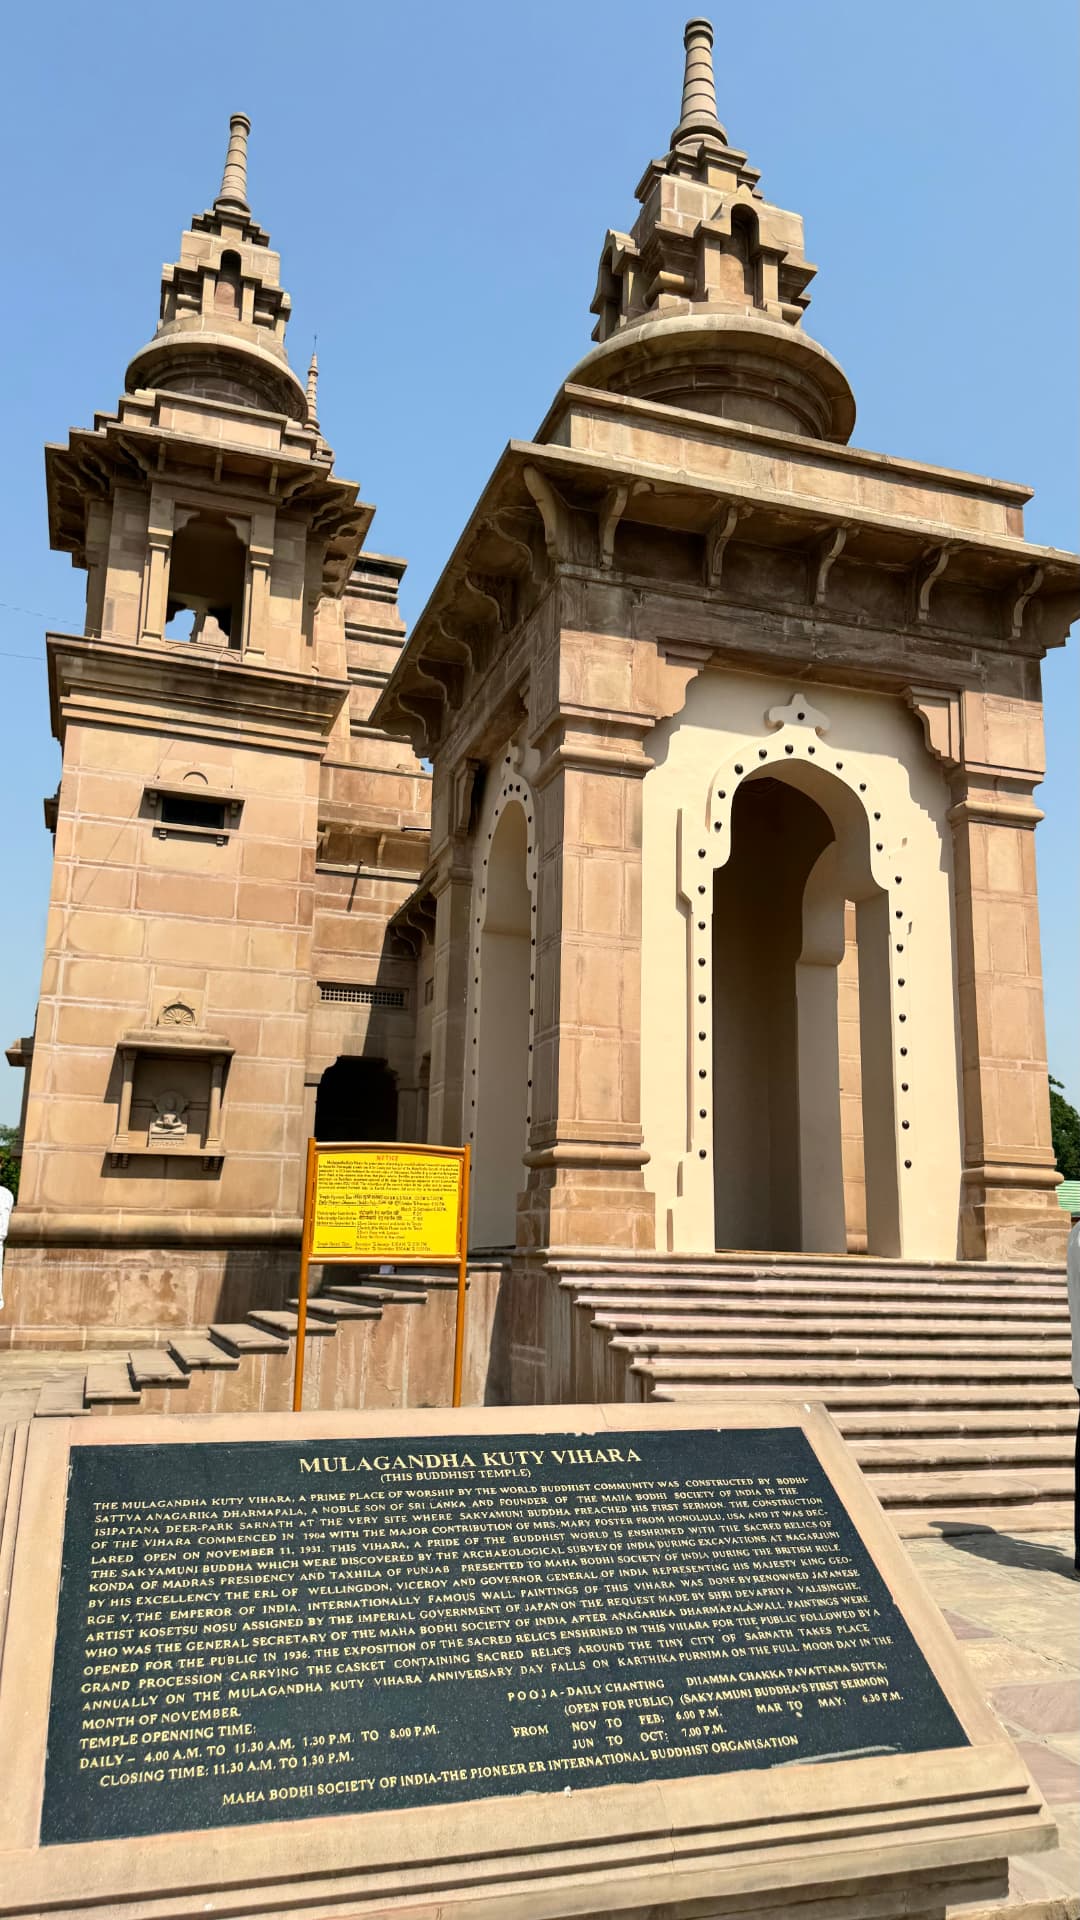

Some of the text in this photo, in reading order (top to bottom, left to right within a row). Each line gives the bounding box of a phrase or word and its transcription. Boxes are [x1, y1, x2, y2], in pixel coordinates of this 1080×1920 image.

[298, 1448, 641, 1472] MULAGANDHA KUTY VIHARA
[380, 1467, 531, 1483] (THIS BUDDHIST TEMPLE)
[92, 1501, 118, 1510] THE
[121, 1498, 207, 1509] MULAGANDHA
[211, 1496, 243, 1505] KUTY
[310, 1492, 346, 1502] PRIME
[349, 1491, 385, 1500] PLACE
[387, 1490, 403, 1498] OF
[404, 1488, 454, 1498] WORSHIP
[457, 1487, 472, 1495] BY
[473, 1487, 497, 1495] THE
[498, 1485, 537, 1493] WORLD
[539, 1483, 590, 1492] BUDDHIST
[593, 1481, 654, 1490] COMMUNITY
[684, 1478, 753, 1487] CONSTRUCTED
[756, 1477, 770, 1485] BY
[94, 1525, 159, 1536] ISIPATANA
[165, 1522, 233, 1533] DEER-PARK
[239, 1520, 293, 1530] SARNATH
[298, 1518, 314, 1527] AT
[319, 1517, 343, 1526] THE
[348, 1516, 378, 1524] VERY
[383, 1514, 408, 1524] SITE
[411, 1512, 452, 1521] WHERE
[459, 1509, 523, 1520] SAKYAMUNI
[526, 1507, 571, 1517] BUDDHA
[573, 1505, 627, 1514] PREACHED
[630, 1504, 648, 1512] HIS
[650, 1503, 679, 1511] FIRST
[727, 1500, 749, 1508] THE
[751, 1497, 823, 1507] CONSTRUCTION
[87, 1598, 105, 1608] BY
[109, 1597, 131, 1607] HIS
[135, 1592, 221, 1605] EXCELLENCY
[223, 1590, 249, 1600] THE
[253, 1589, 278, 1598] ERL
[281, 1587, 298, 1597] OF
[395, 1579, 448, 1590] VICEROY
[452, 1577, 475, 1587] AND
[479, 1574, 543, 1585] GOVERNOR
[546, 1571, 598, 1581] GENERAL
[599, 1569, 614, 1577] OF
[618, 1567, 648, 1576] INDIA
[651, 1562, 729, 1575] REPRESENTING
[731, 1561, 749, 1570] HIS
[752, 1559, 796, 1570] MAJESTY
[799, 1557, 825, 1566] KING
[85, 1601, 558, 1642] ARTIST KOSETSU NOSU ASSIGNED BY THE IMPERIAL GOVERNMENT OF JAPAN
[80, 1623, 870, 1693] GRAND PROCESSION CARRYING THE CASKET CONTAINING SACRED RELICS AROUND THE TINY CITY OF SARNATH TAKES PLACE
[563, 1675, 888, 1716] (OPEN FOR PUBLIC) (SAKYAMUNI BUDDHA'S FIRST SERMON)
[565, 1684, 601, 1696] DAILY
[604, 1678, 664, 1692] CHANTING
[685, 1673, 737, 1687] DHAMMA
[738, 1669, 785, 1682] CHAKKA
[785, 1664, 850, 1677] PAVATTANA
[81, 1715, 134, 1730] MONTH
[138, 1713, 158, 1725] OF
[510, 1723, 549, 1738] FROM
[571, 1719, 596, 1732] NOV
[604, 1717, 622, 1728] TO
[675, 1709, 695, 1720] 6.00
[755, 1702, 783, 1714] MAR
[786, 1700, 803, 1711] TO
[861, 1693, 880, 1703] 6.30
[78, 1733, 138, 1749] TEMPLE
[140, 1726, 213, 1743] OPENNING
[79, 1753, 124, 1769] DAILY
[143, 1750, 169, 1762] 4.00
[205, 1744, 225, 1756] TO
[234, 1740, 263, 1754] 11.30
[302, 1735, 325, 1747] 1.30
[360, 1729, 379, 1742] TO
[389, 1727, 411, 1739] 8.00
[572, 1737, 594, 1749] JUN
[604, 1734, 623, 1746] TO
[680, 1726, 701, 1737] 7.00
[99, 1768, 165, 1787] CLOSING
[212, 1761, 243, 1775] 11.30
[278, 1753, 297, 1769] TO
[301, 1754, 324, 1768] 1.30
[221, 1790, 265, 1807] MAHA
[268, 1784, 313, 1800] BODHI
[317, 1777, 375, 1795] SOCIETY
[379, 1775, 397, 1790] OF
[470, 1762, 527, 1779] PIONEER
[528, 1760, 546, 1772] ER
[546, 1750, 649, 1771] INTERNATIONAL
[649, 1743, 708, 1760] BUDDHIST
[711, 1734, 798, 1753] ORGANISATION
